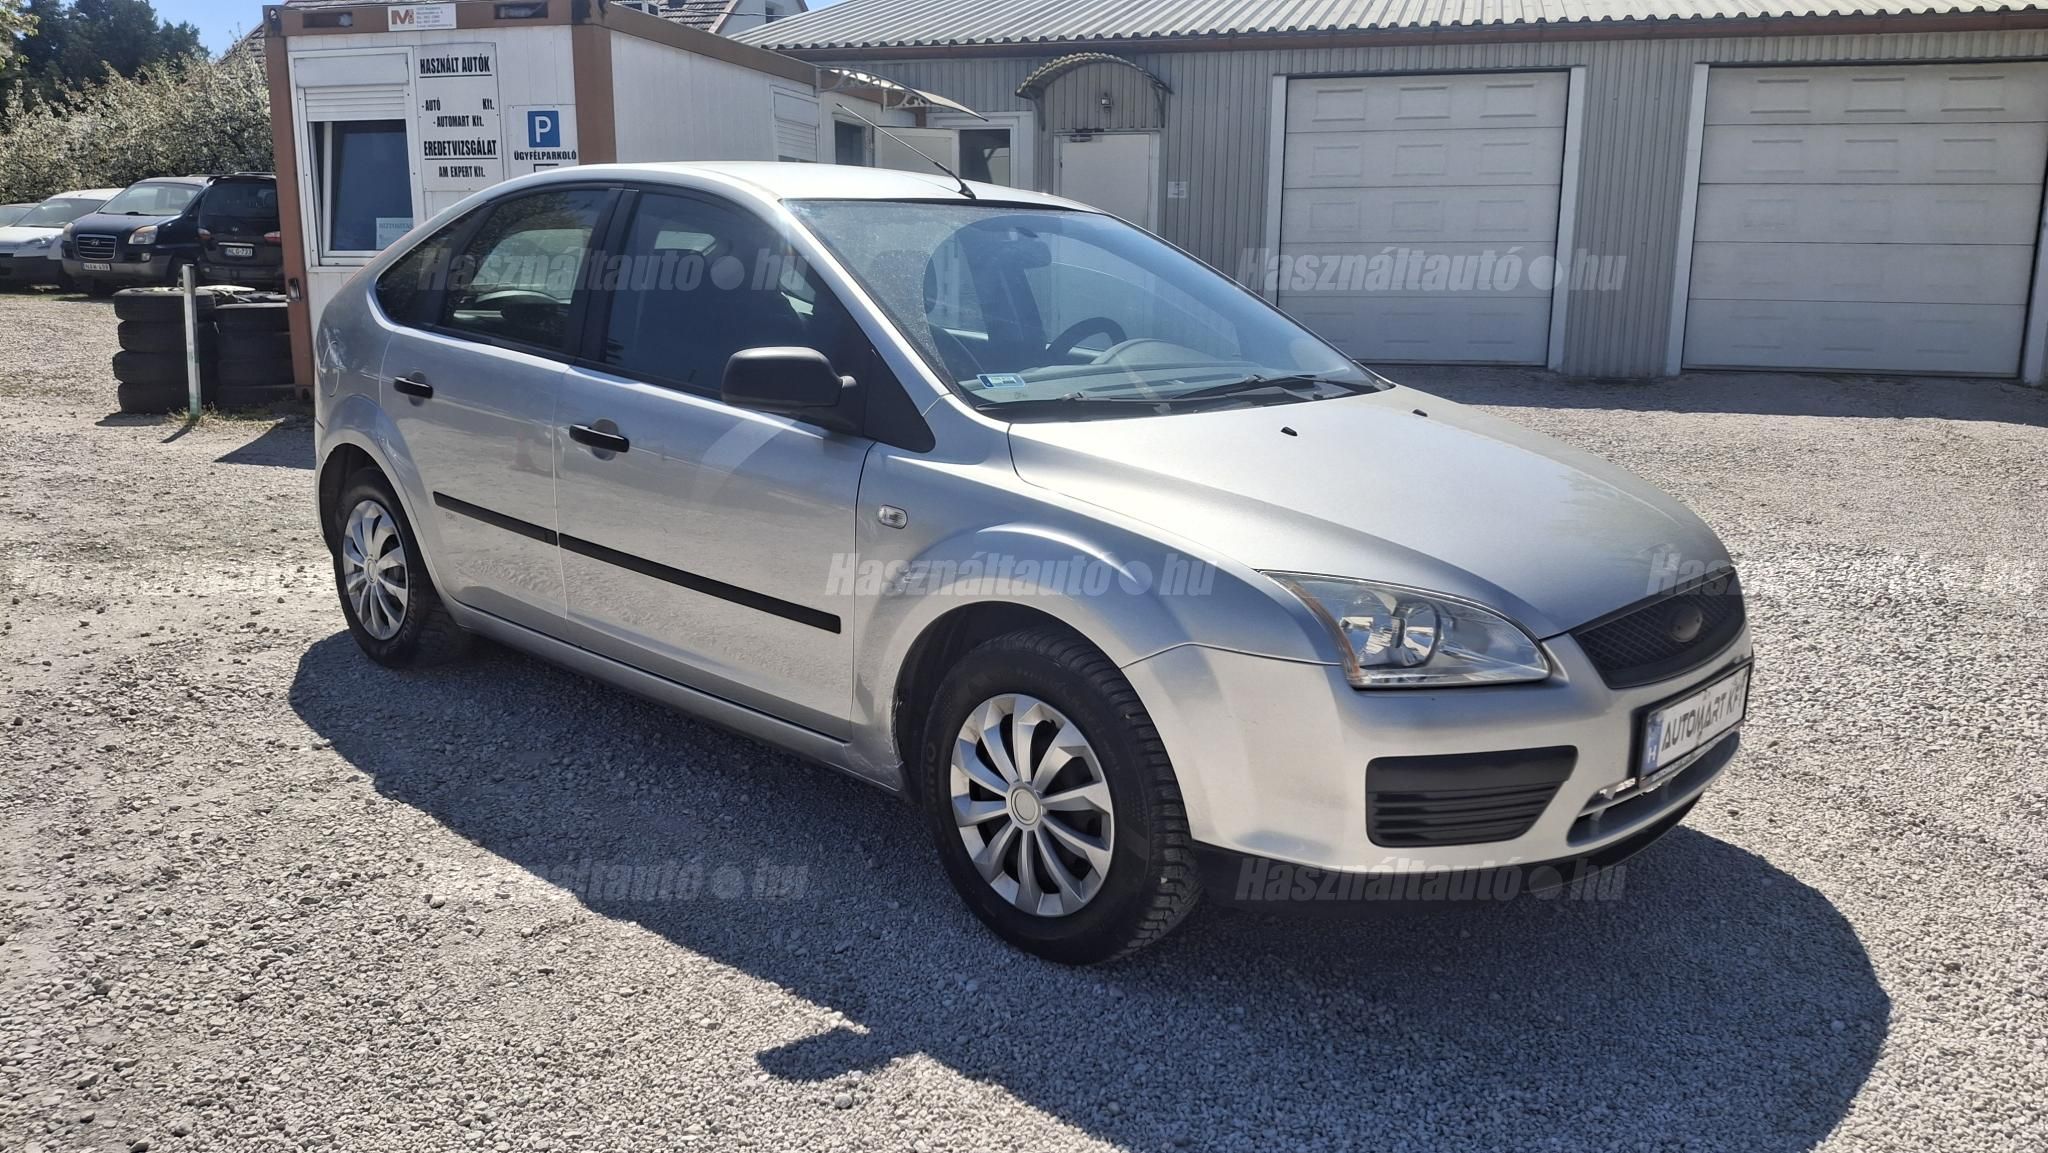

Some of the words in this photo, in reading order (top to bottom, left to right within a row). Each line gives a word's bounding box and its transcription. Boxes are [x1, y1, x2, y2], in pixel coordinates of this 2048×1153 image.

[420, 54, 459, 74] HASZNÁLT
[462, 53, 490, 73] AUTÓK
[472, 115, 484, 127] Kft.
[535, 115, 551, 143] P
[424, 137, 496, 156] EREDETVIZSGÁLAT
[514, 150, 577, 161] ÜGYFÉLPARKOLÓ
[439, 166, 449, 178] AM
[450, 166, 473, 178] EXPERT
[474, 166, 486, 178] Kft.
[1661, 691, 1727, 753] AUTOMART
